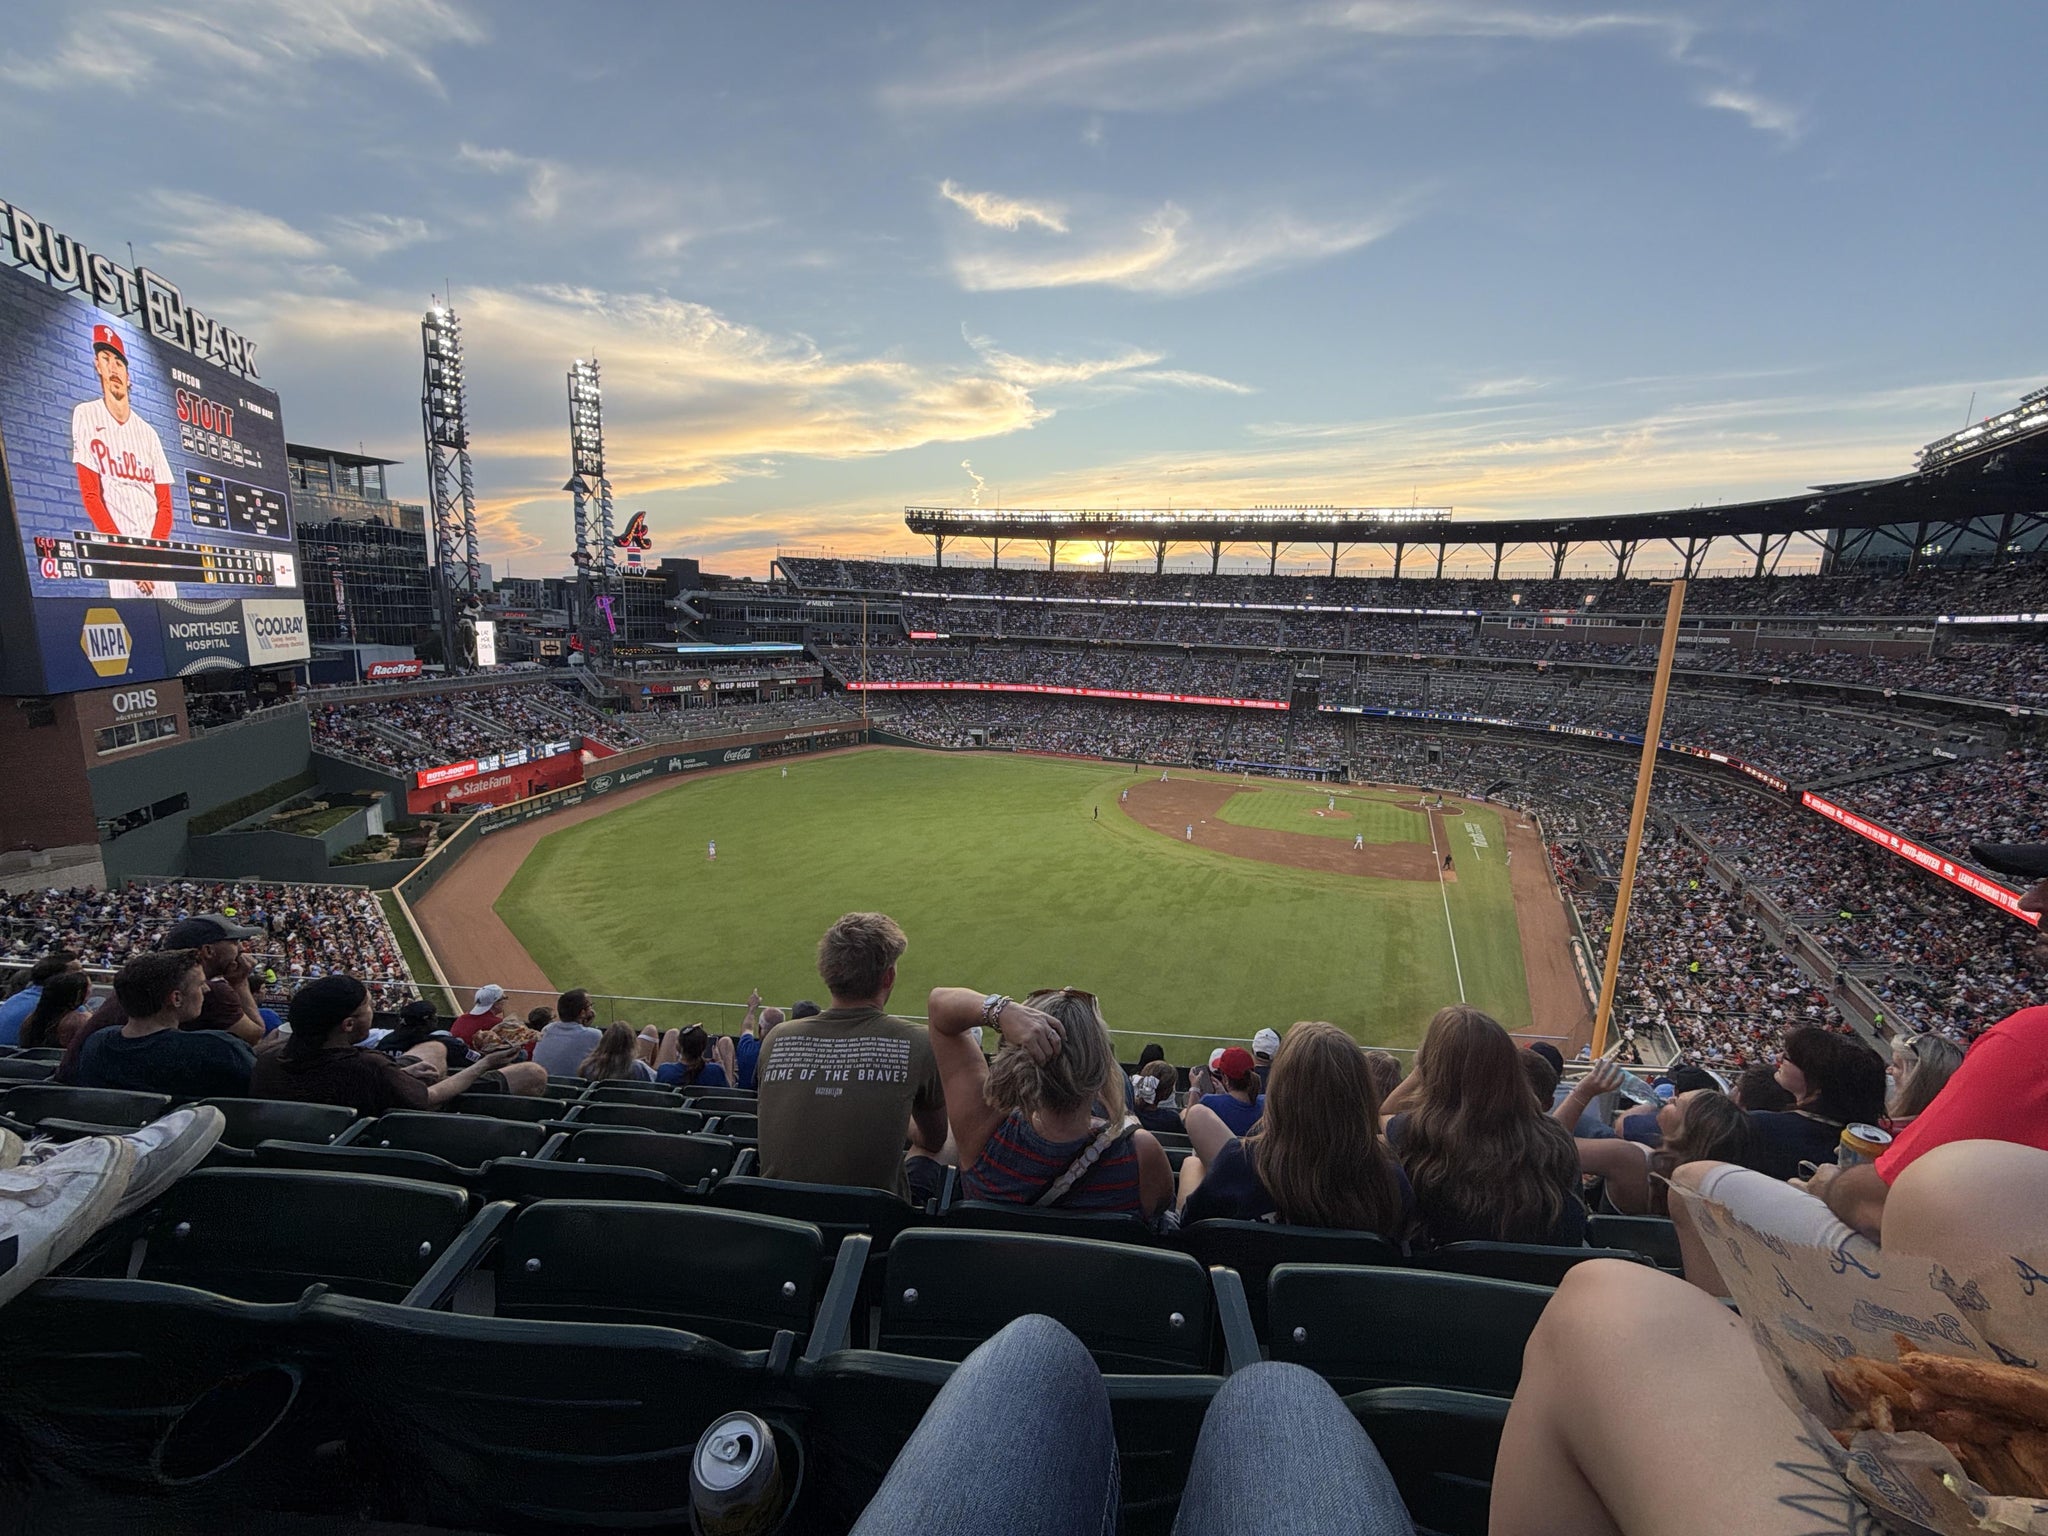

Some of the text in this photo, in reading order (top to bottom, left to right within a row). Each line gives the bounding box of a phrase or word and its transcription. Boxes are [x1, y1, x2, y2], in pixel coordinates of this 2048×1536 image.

[187, 307, 261, 379] PARK
[171, 368, 201, 389] BRYSON
[176, 387, 234, 438] STOTT
[81, 545, 88, 557] 1
[246, 560, 252, 569] 2
[265, 558, 271, 572] 1
[84, 564, 92, 576] 0
[248, 574, 253, 583] 2
[169, 621, 240, 638] NORTHSIDE
[255, 617, 303, 637] COOLRAY
[89, 627, 126, 657] NAPA
[185, 638, 230, 651] HOSPITAL
[372, 663, 417, 676] RaceTrac
[737, 680, 759, 689] HOUSE
[112, 688, 157, 713] ORIS
[764, 1069, 908, 1083] HOME OF THE BRAVE?
